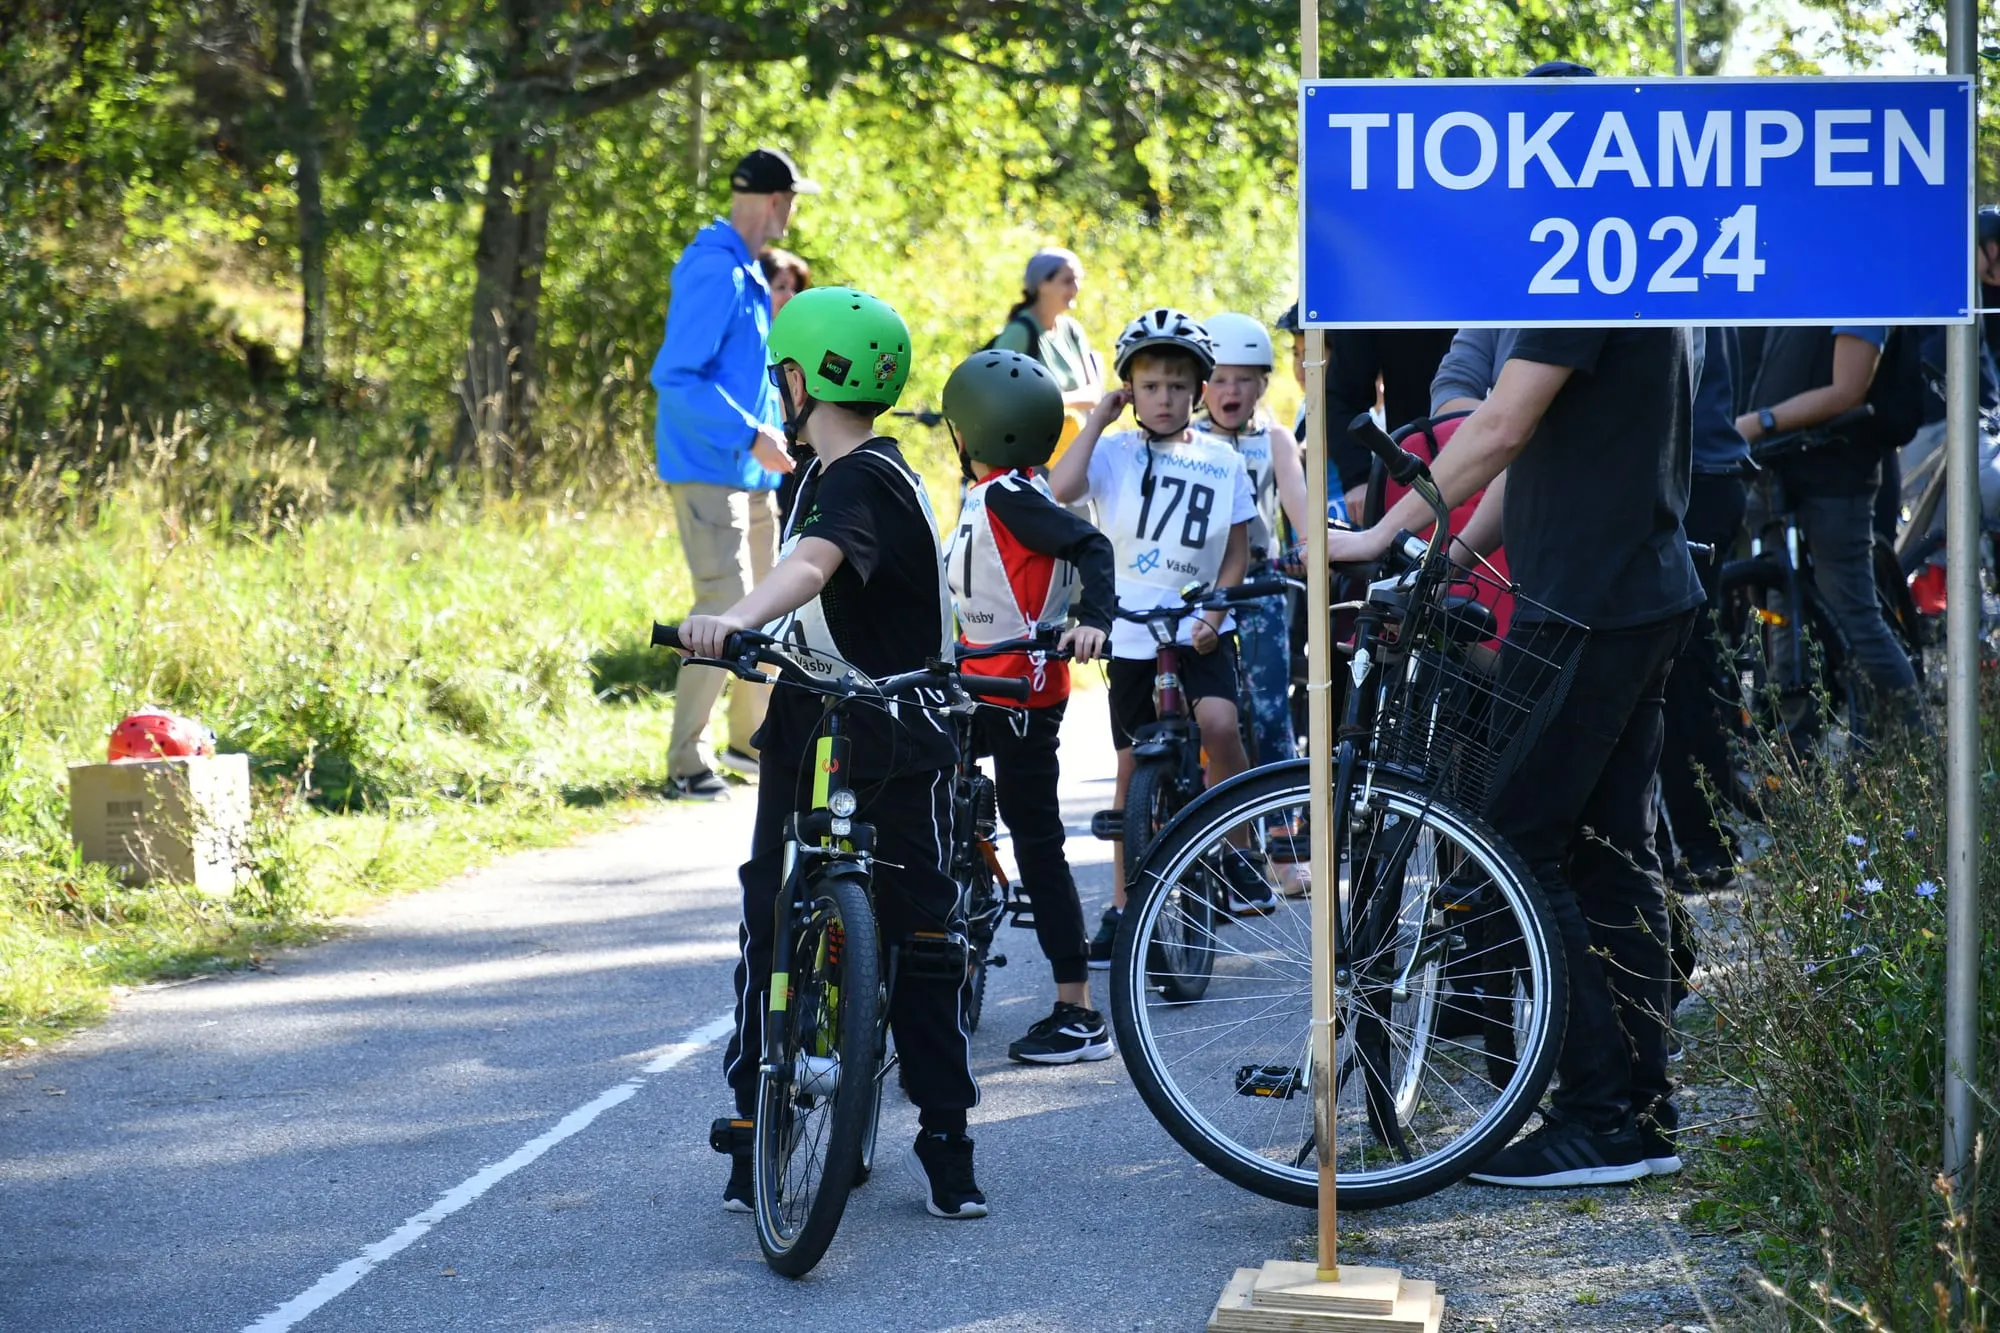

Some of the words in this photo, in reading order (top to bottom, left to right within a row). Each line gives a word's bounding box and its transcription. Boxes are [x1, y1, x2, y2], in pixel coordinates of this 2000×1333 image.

[1328, 108, 1946, 191] TIOKAMPEN
[1527, 204, 1766, 295] 2024
[1136, 474, 1215, 550] 178
[1166, 559, 1200, 577] Väsby
[964, 611, 994, 624] Väsby
